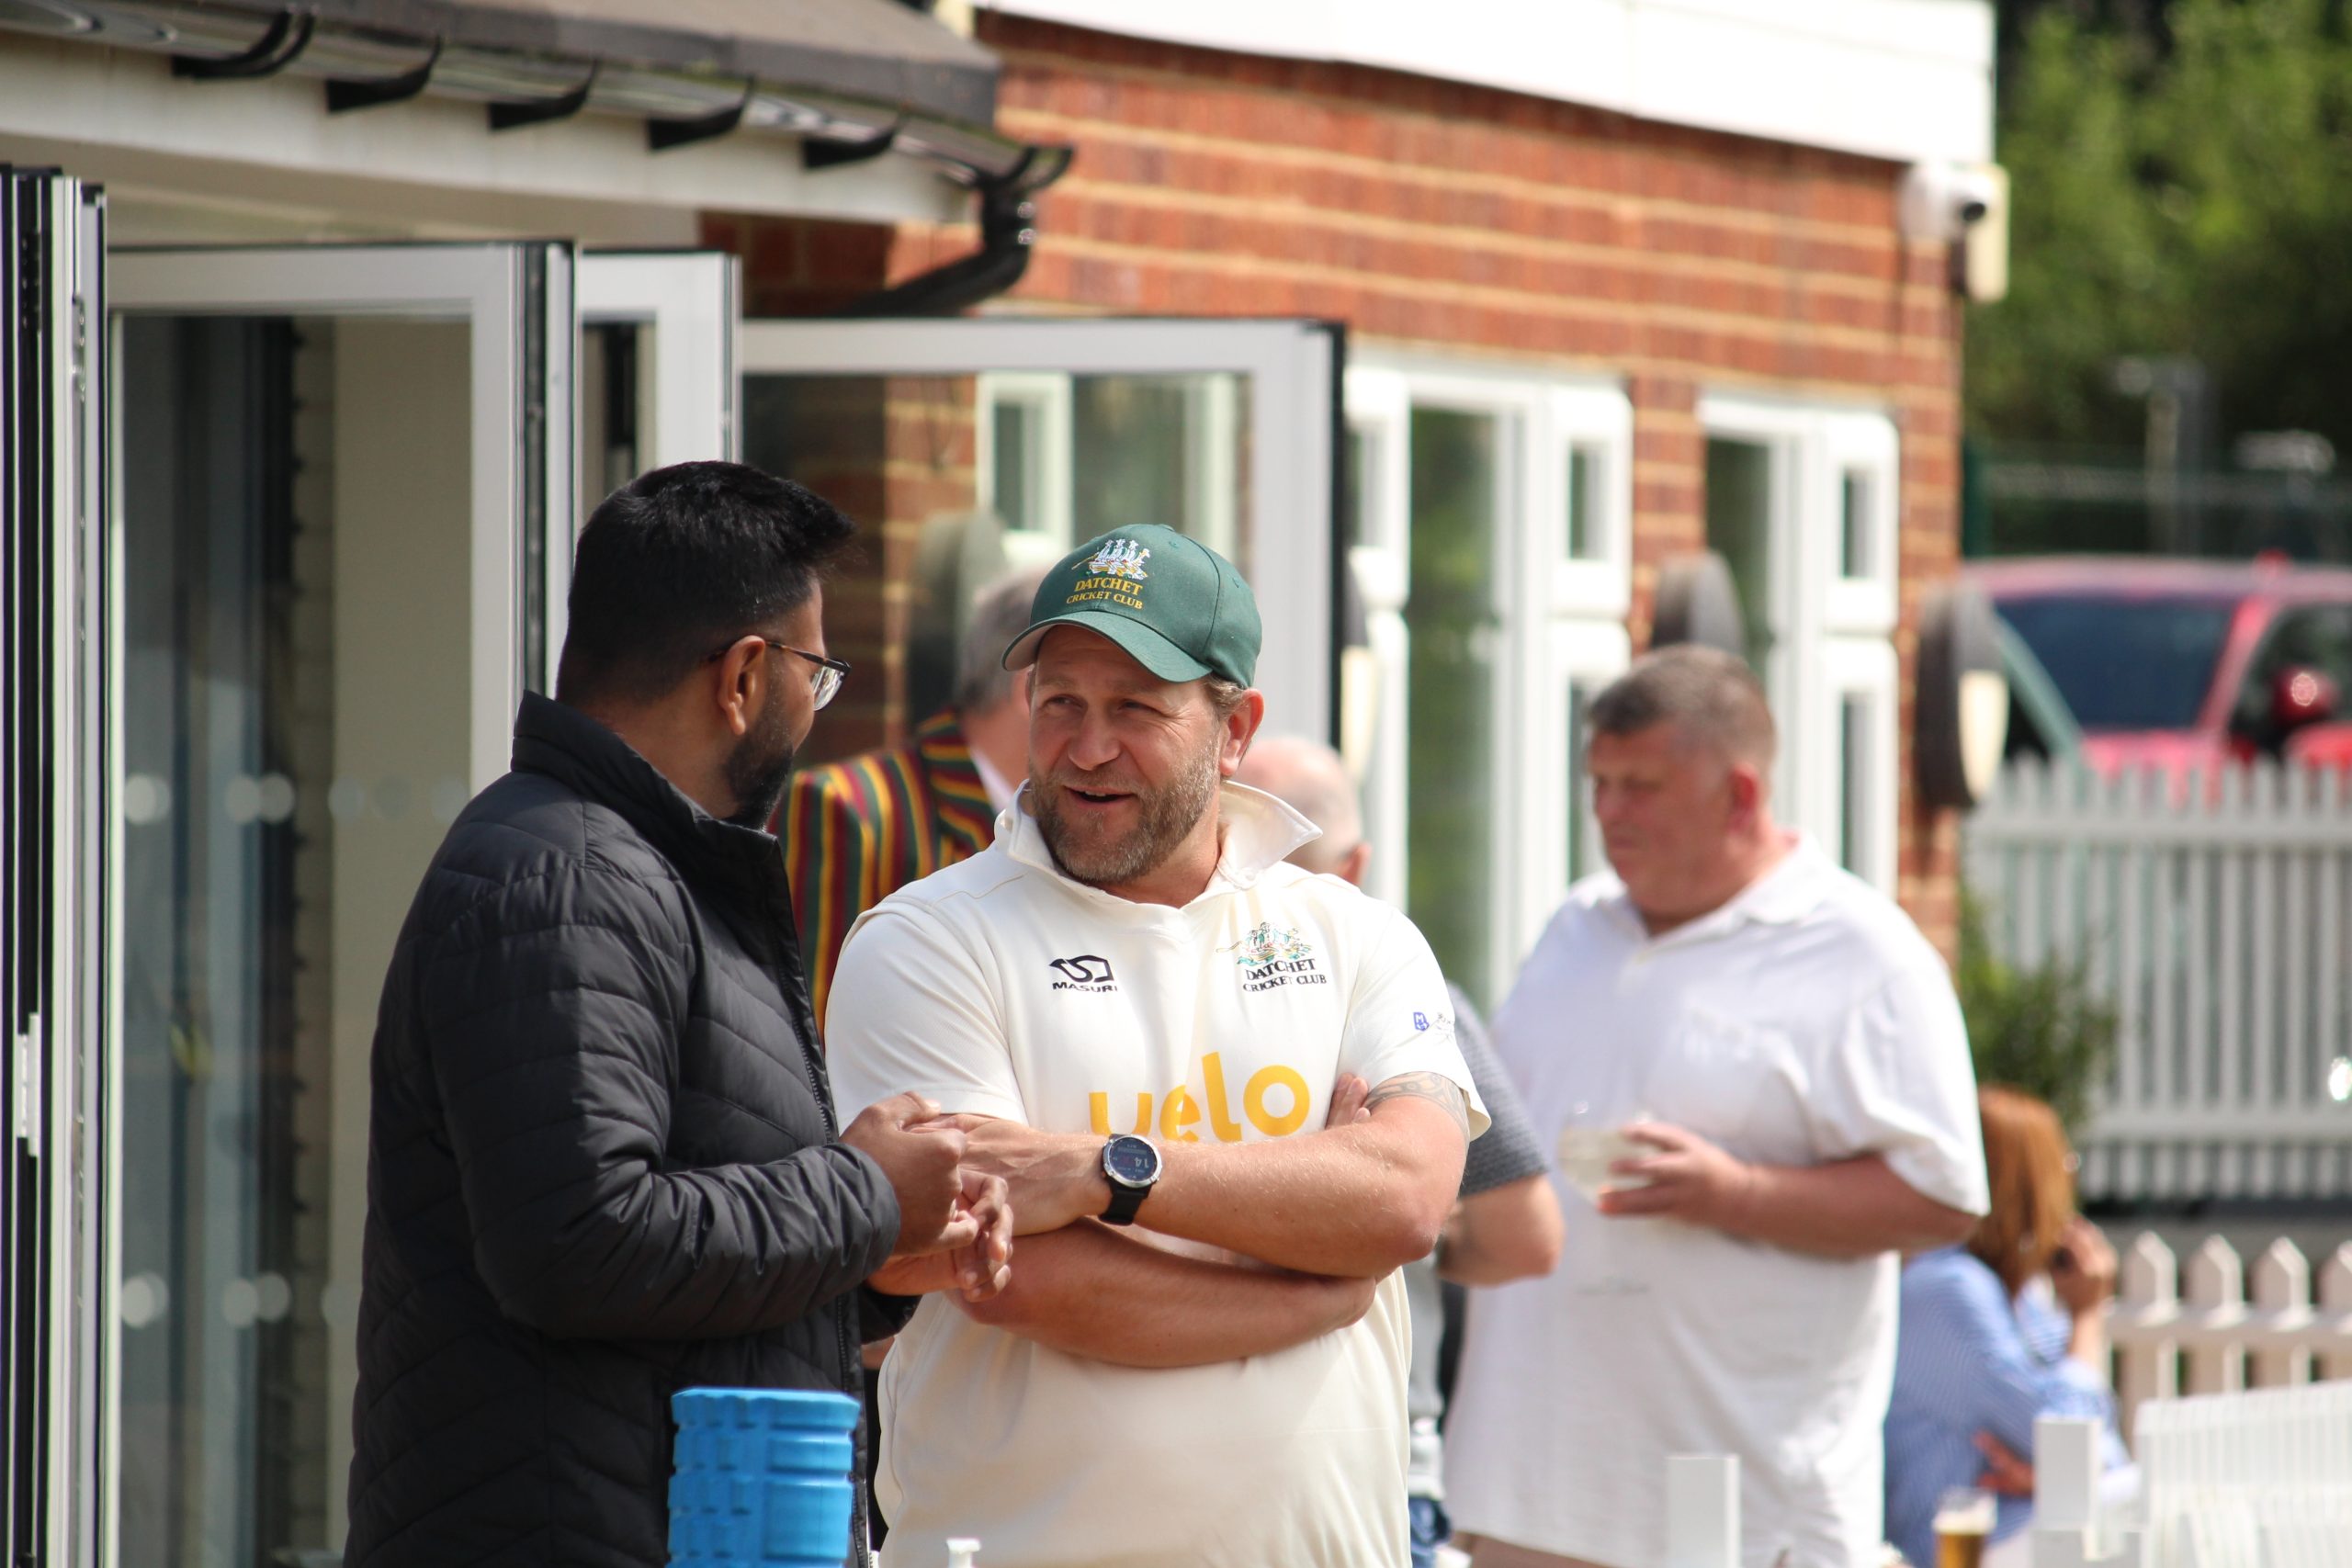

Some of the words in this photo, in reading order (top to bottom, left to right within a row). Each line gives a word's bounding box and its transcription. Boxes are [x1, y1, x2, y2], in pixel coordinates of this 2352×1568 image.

[1074, 577, 1143, 596] DATCHET
[1066, 591, 1112, 605] CRICKET
[1114, 593, 1144, 610] CLUB
[1245, 958, 1316, 981] DATCHET
[1052, 981, 1118, 993] MASURI
[1242, 976, 1293, 993] CRICKET
[1296, 974, 1327, 985] CLUB
